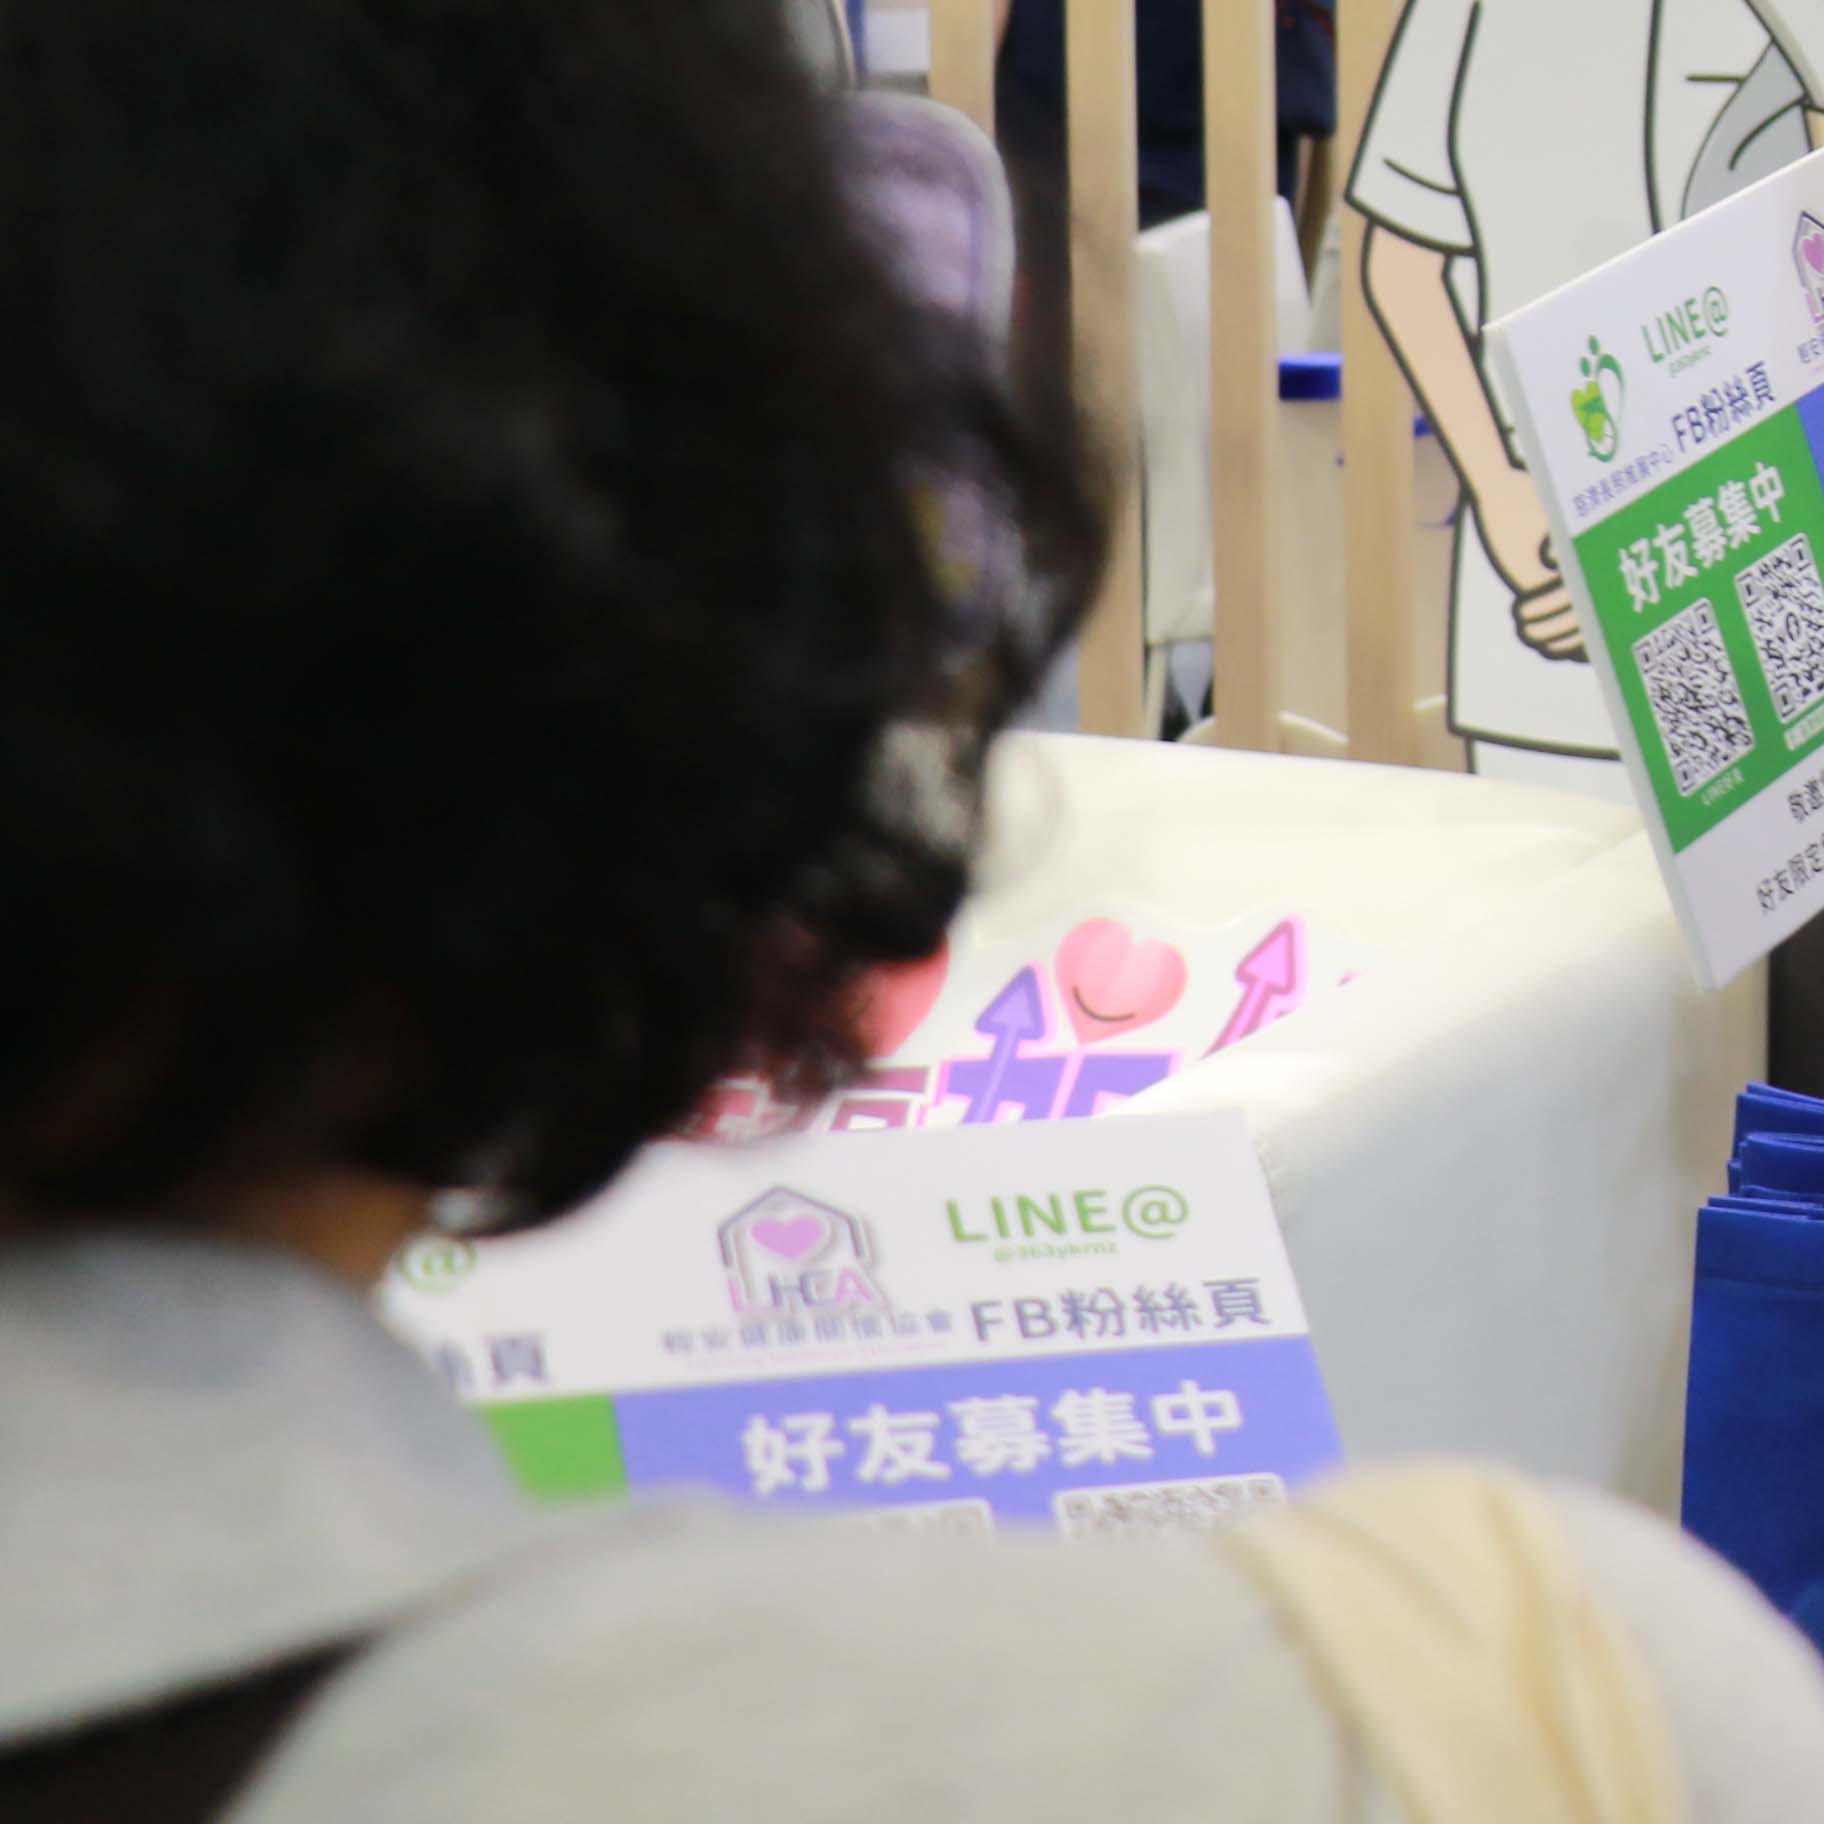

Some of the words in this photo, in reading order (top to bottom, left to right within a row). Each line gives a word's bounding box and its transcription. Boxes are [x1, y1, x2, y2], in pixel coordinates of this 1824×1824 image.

[1641, 286, 1729, 363] LINE@
[1672, 361, 1776, 453] FB粉絲頁
[1618, 461, 1786, 614] 好友募集中
[945, 1185, 1189, 1244] LINE@
[969, 1277, 1272, 1343] FB粉絲頁
[740, 1379, 1244, 1498] 好友募集中
